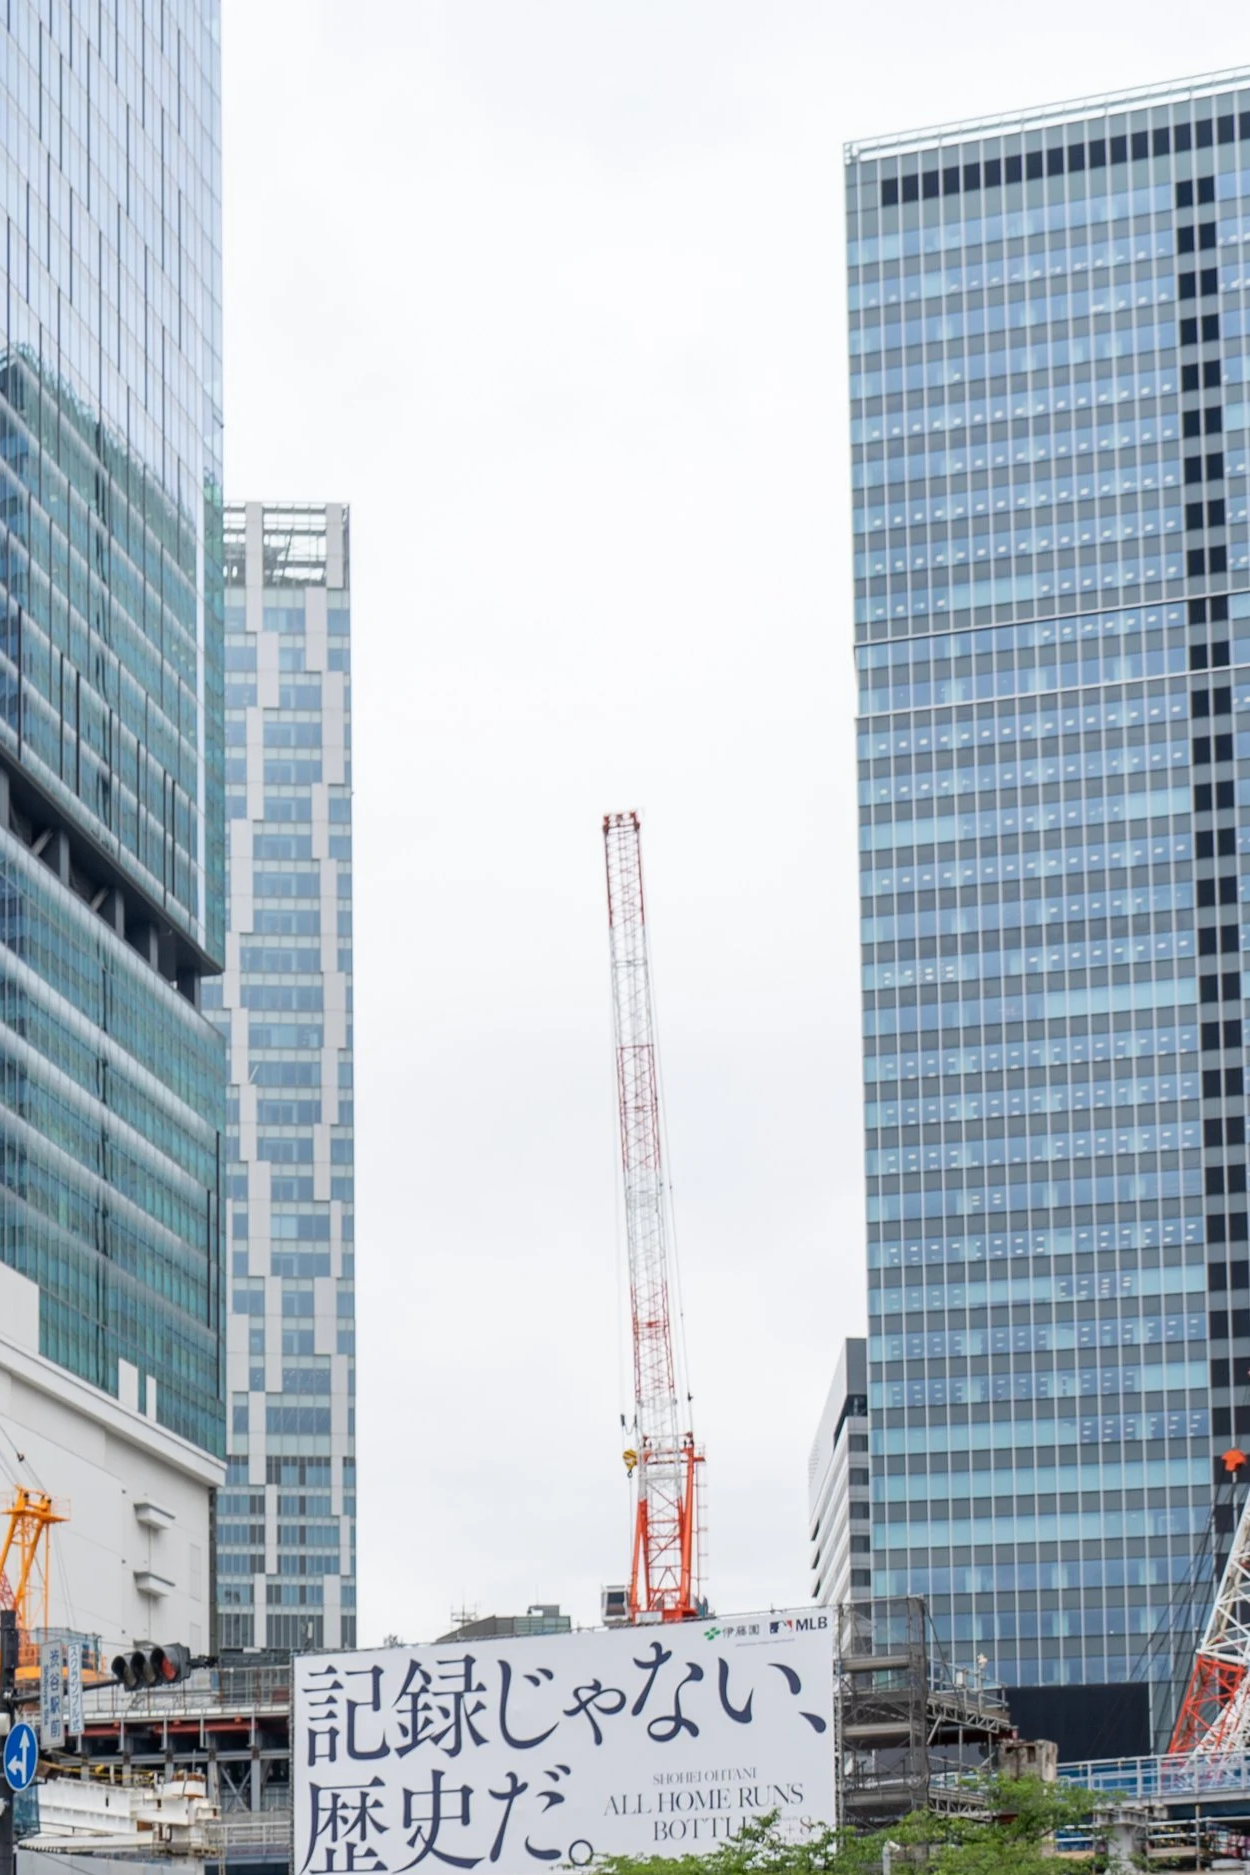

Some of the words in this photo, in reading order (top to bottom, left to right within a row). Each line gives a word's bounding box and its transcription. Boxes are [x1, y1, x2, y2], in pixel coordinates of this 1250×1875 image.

[722, 1624, 760, 1639] 伊藤園
[796, 1616, 828, 1632] MLB
[49, 1649, 61, 1738] 渋谷駅前
[302, 1641, 827, 1767] 記録じゃない、
[652, 1771, 701, 1786] SHOHEI
[704, 1767, 757, 1782] OHTANI
[603, 1793, 652, 1816] ALL
[657, 1788, 732, 1813] HOME
[738, 1783, 804, 1809] RUNS
[299, 1764, 594, 1875] 歴史だ。
